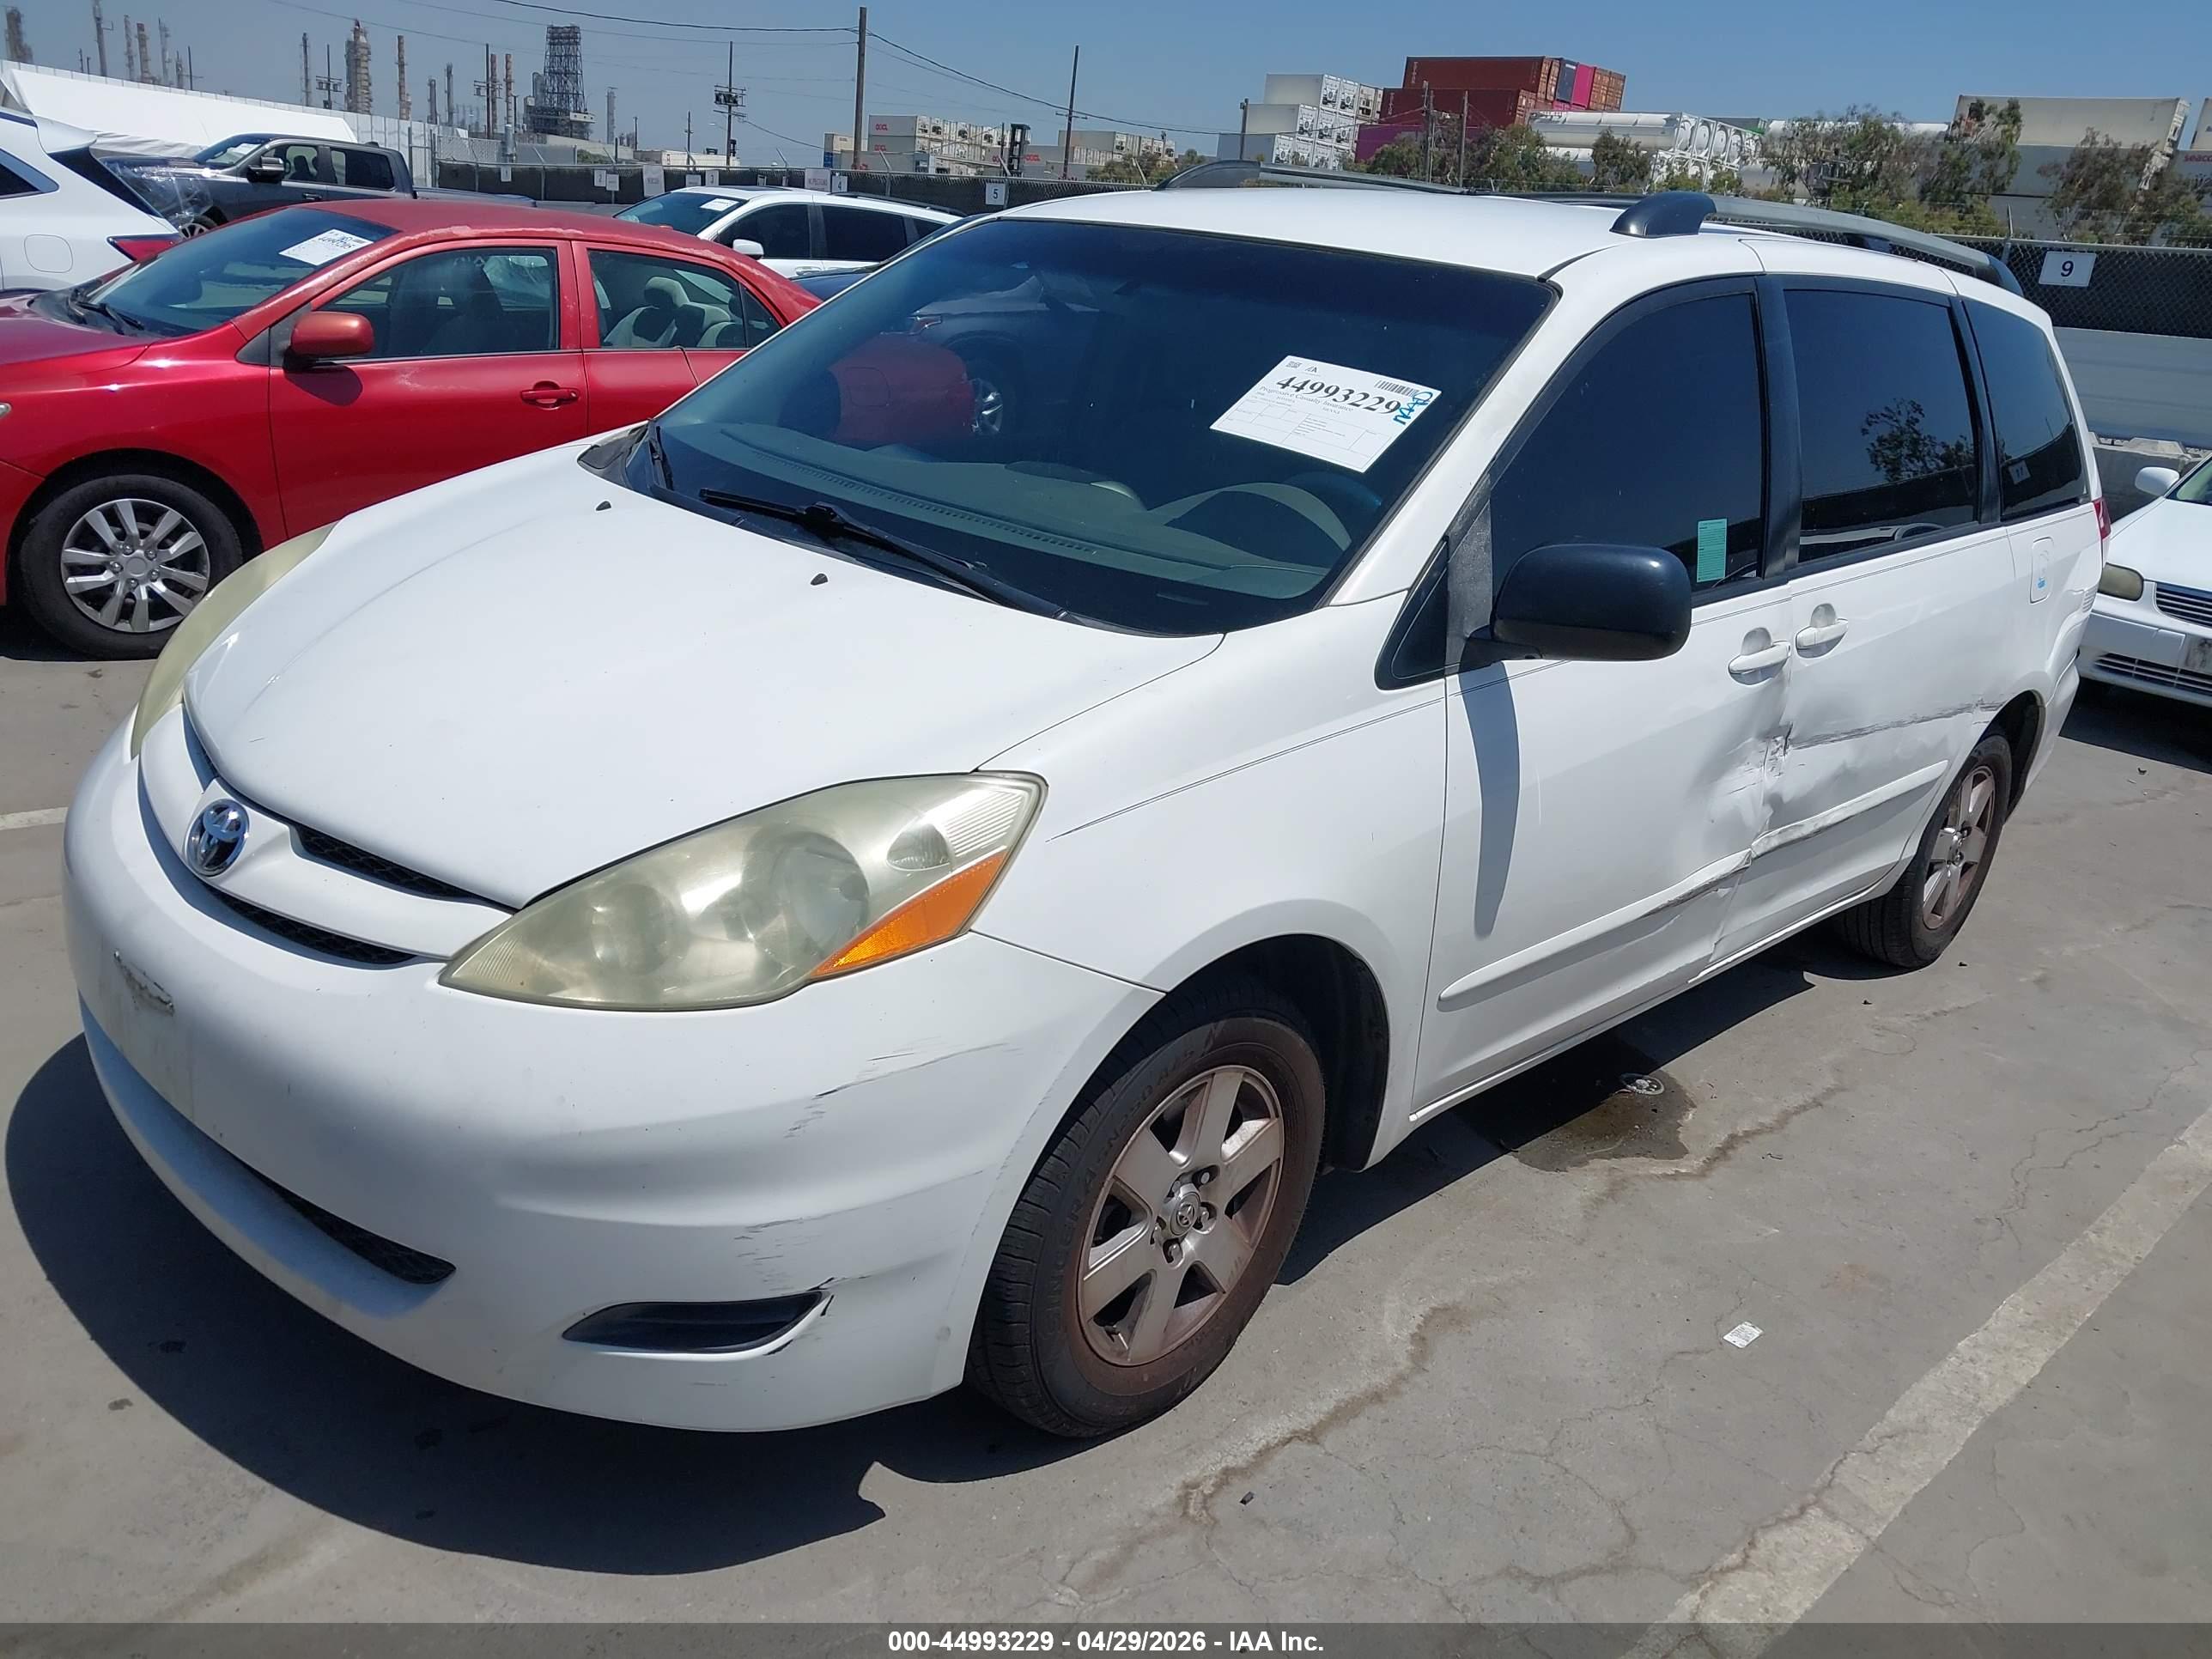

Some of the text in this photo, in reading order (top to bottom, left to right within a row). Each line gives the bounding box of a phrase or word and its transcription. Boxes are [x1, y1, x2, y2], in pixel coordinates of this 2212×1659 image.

[837, 180, 842, 191] 4
[993, 188, 999, 199] 5
[2060, 260, 2075, 277] 9
[1276, 376, 1401, 415] 44993229
[1322, 399, 1354, 412] Insurance
